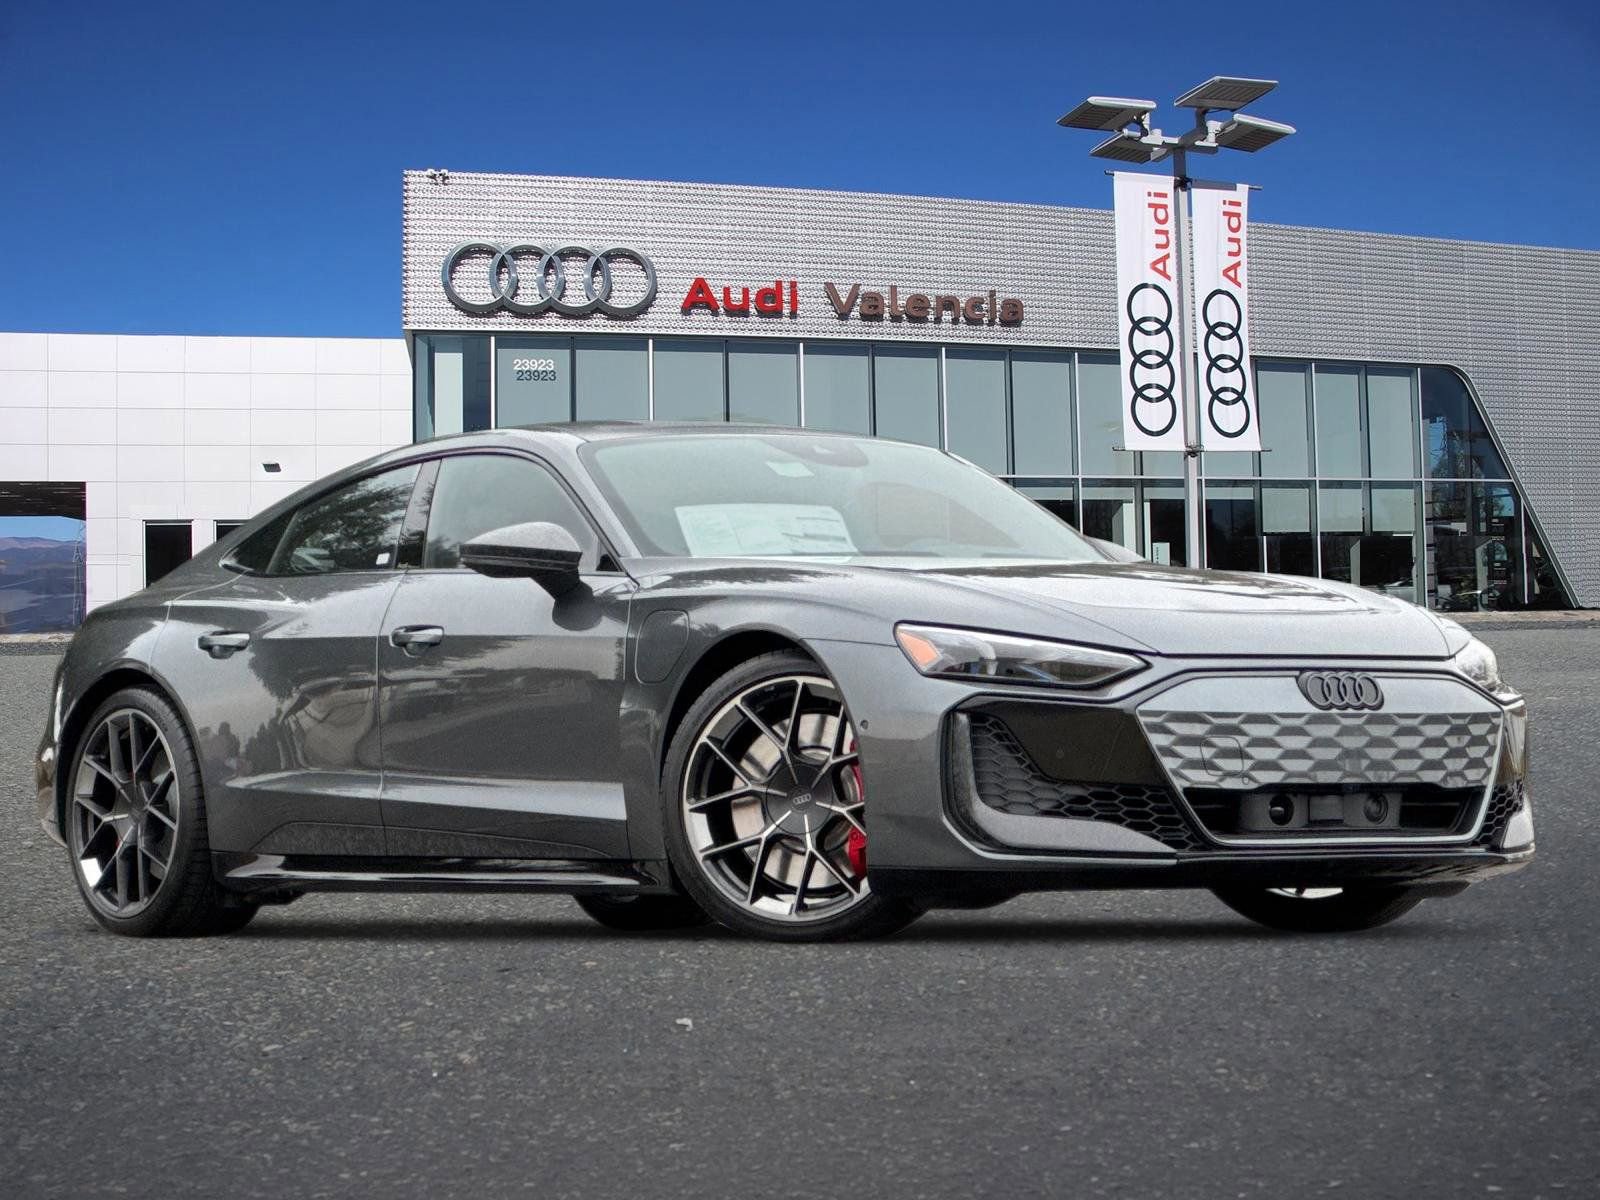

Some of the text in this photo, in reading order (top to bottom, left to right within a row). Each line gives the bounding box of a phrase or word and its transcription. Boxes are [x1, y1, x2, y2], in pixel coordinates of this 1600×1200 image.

[1147, 191, 1172, 281] Audi
[1222, 199, 1242, 288] Audi
[682, 277, 1024, 325] Audi Valencia
[513, 359, 554, 370] 23923
[516, 370, 556, 381] 23923
